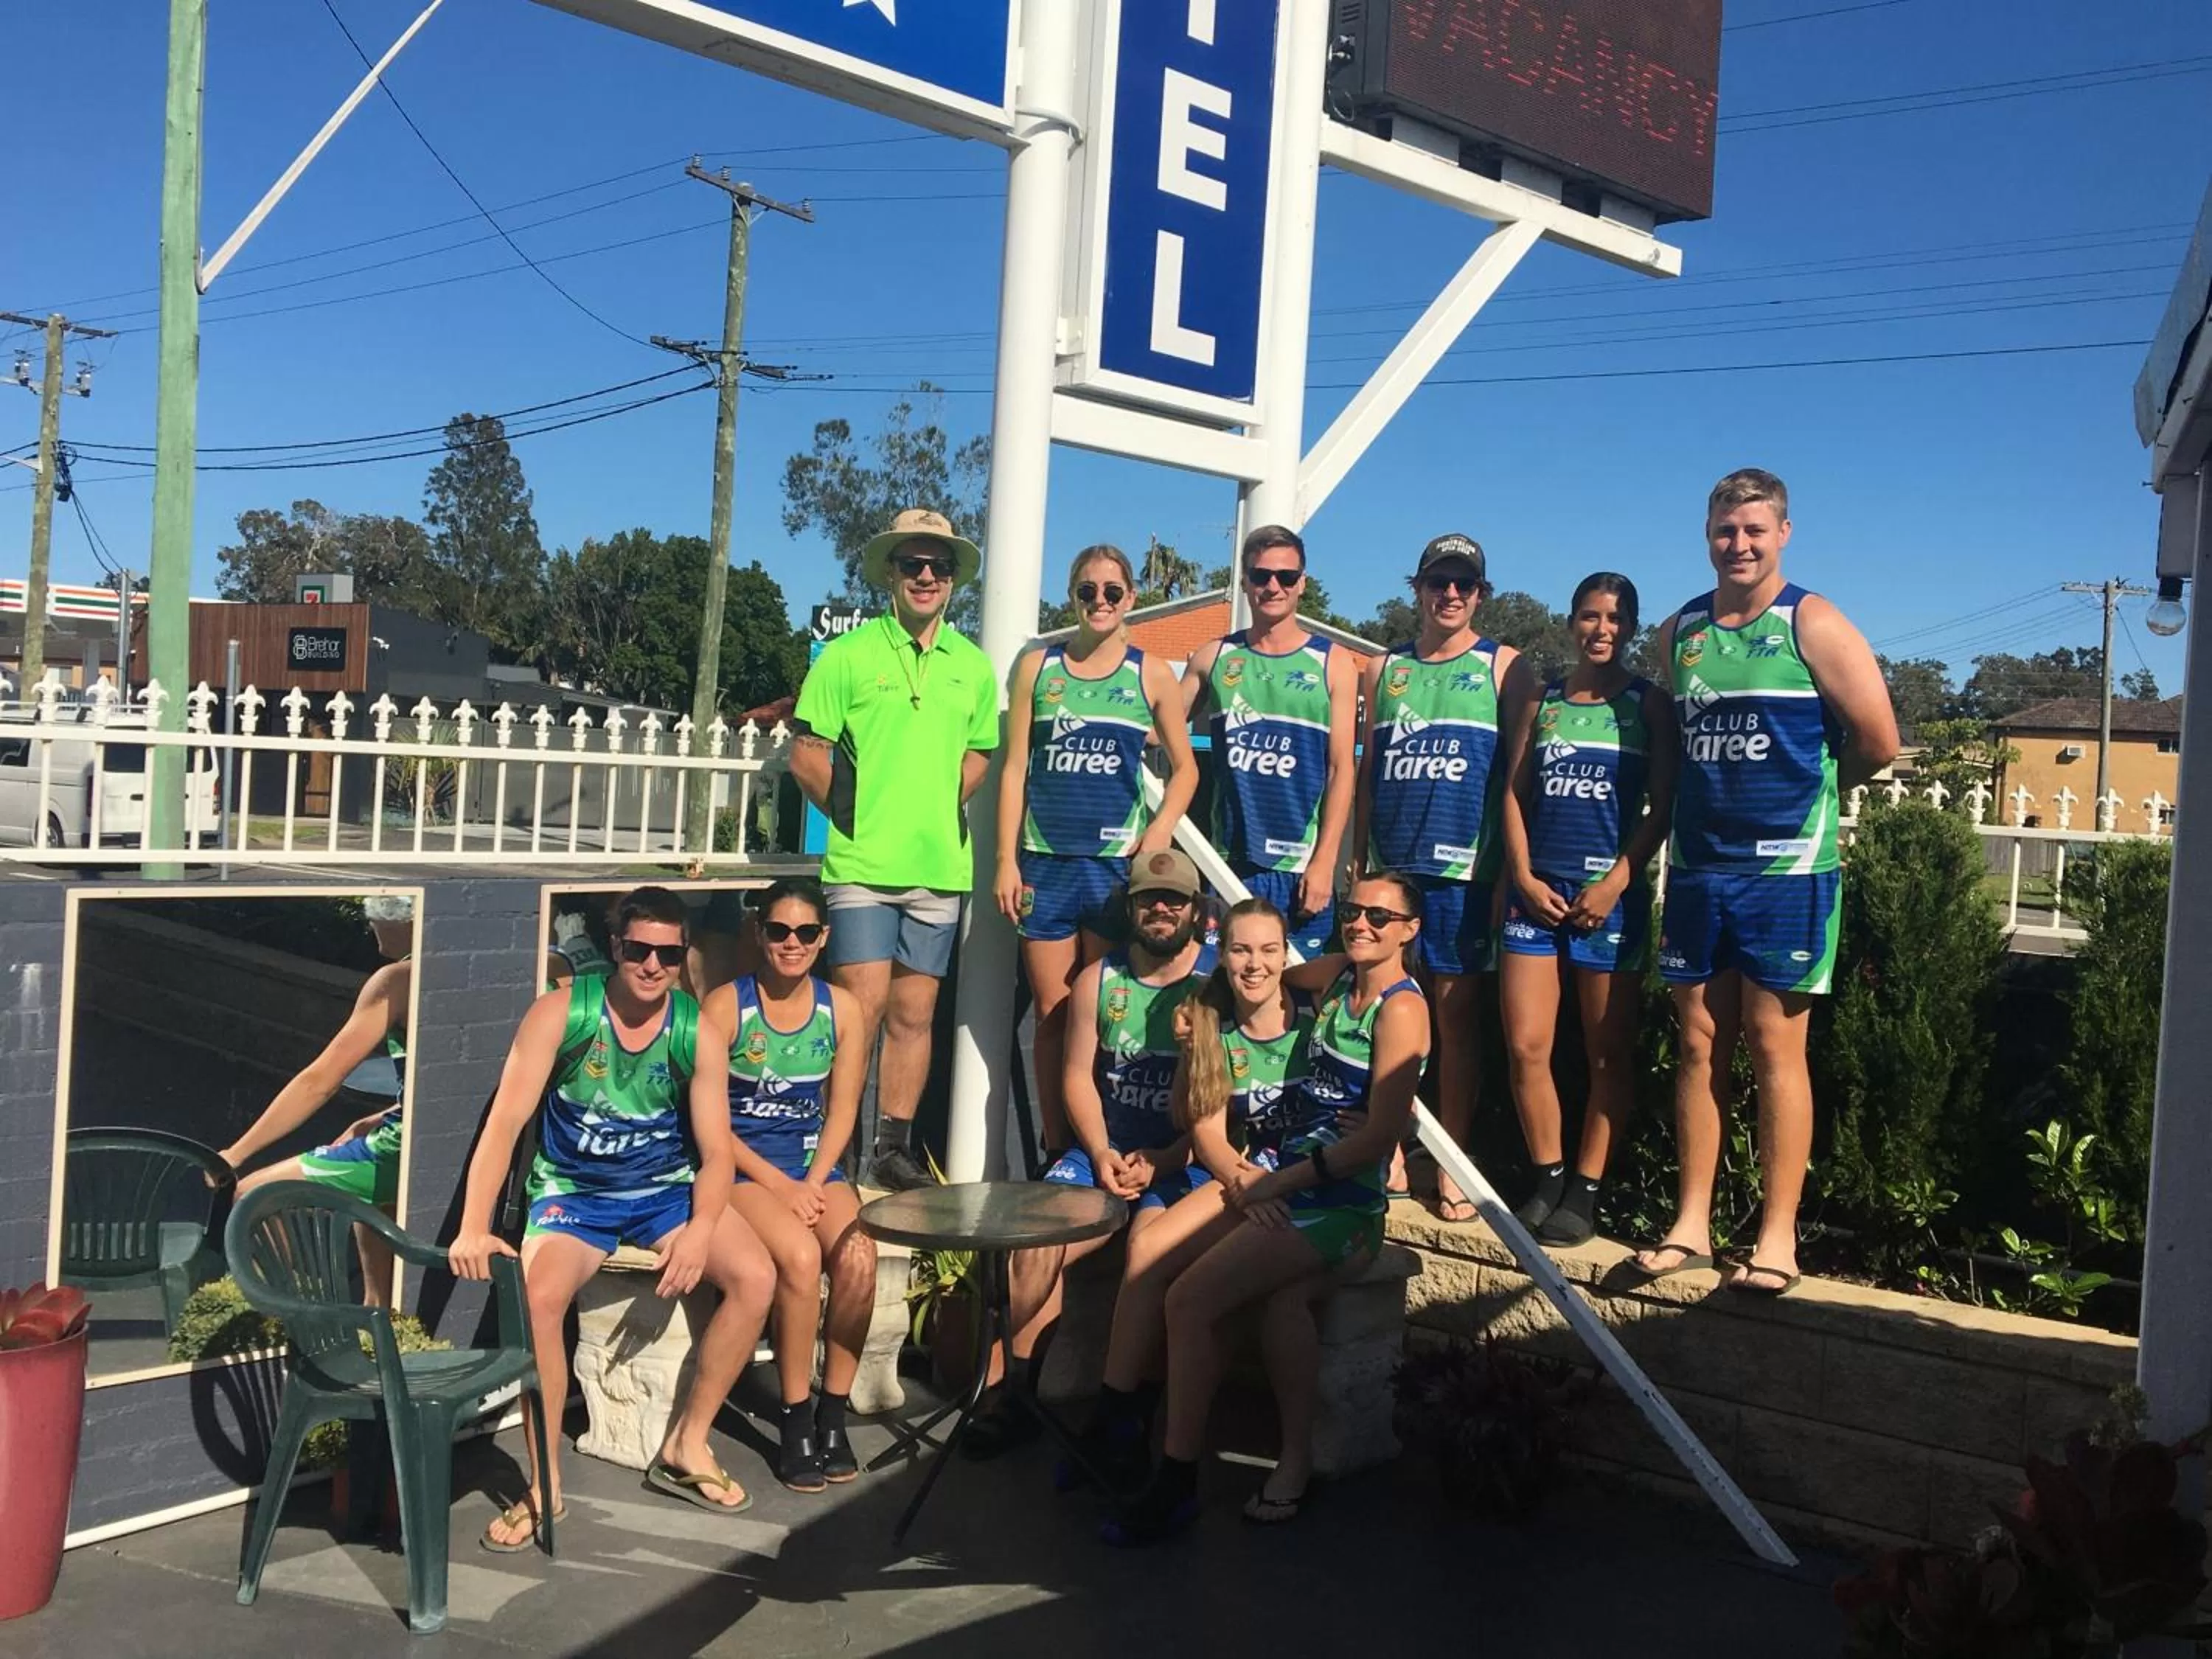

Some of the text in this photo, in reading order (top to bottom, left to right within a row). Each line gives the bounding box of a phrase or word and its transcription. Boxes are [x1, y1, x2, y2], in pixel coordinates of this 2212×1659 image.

[1700, 713, 1759, 732] CLUB
[1065, 737, 1116, 752] CLUB
[1237, 731, 1292, 751] CLUB
[1405, 740, 1461, 754] CLUB
[1677, 726, 1771, 762] Taree
[1044, 745, 1121, 775] Taree
[1383, 750, 1468, 781] Taree
[1555, 762, 1605, 778] CLUB
[1129, 1068, 1171, 1086] CLU
[1107, 1072, 1174, 1113] Tare
